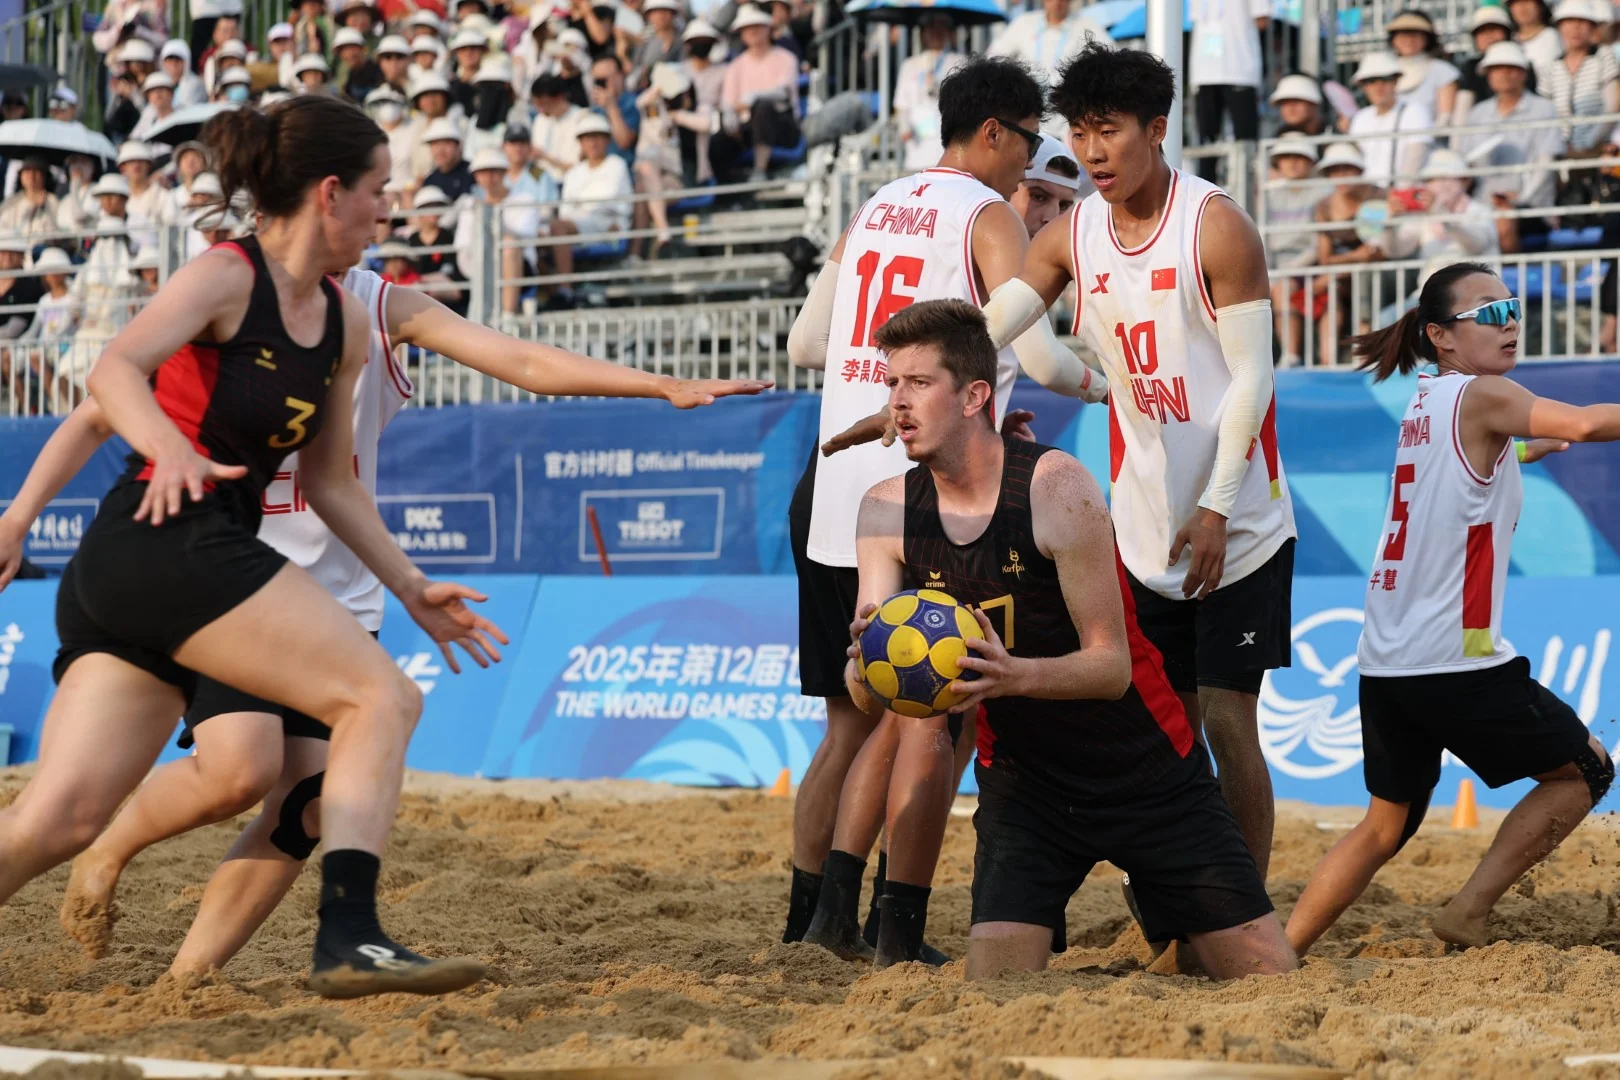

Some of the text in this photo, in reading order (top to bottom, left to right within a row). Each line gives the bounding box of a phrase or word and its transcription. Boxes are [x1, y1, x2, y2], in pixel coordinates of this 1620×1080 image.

[864, 203, 939, 239] CHINA
[850, 249, 925, 347] 16
[1114, 319, 1159, 375] 10
[268, 396, 317, 449] 3
[1397, 415, 1431, 449] HINA
[617, 519, 685, 539] TISSOT
[1383, 463, 1416, 561] 5
[925, 580, 946, 588] erima
[965, 593, 1015, 650] 7
[556, 690, 828, 722] THE WORLD GAMES 202
